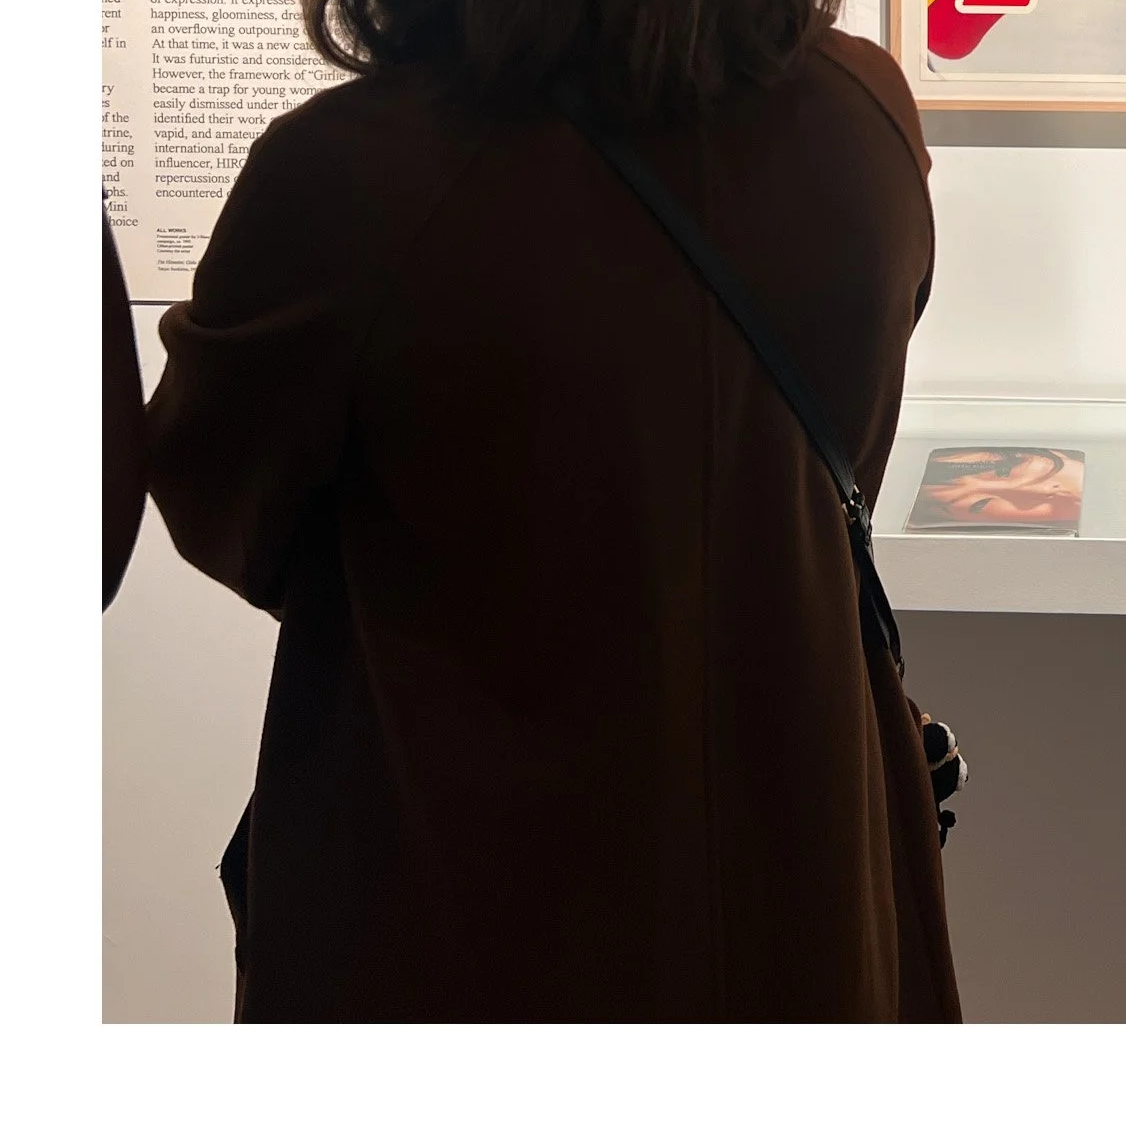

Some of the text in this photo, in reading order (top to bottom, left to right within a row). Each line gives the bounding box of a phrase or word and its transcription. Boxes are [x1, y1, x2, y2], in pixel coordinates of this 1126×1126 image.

[150, 8, 208, 22] happiness,
[212, 9, 277, 23] gloominess,
[151, 26, 165, 34] an
[168, 23, 235, 38] overflowing
[238, 25, 299, 38] outpouring
[116, 38, 126, 48] in
[152, 39, 165, 49] At
[168, 38, 188, 49] that
[192, 38, 218, 50] time,
[223, 39, 229, 49] it
[232, 42, 254, 50] was
[257, 42, 263, 50] a
[267, 42, 290, 50] new
[153, 53, 159, 64] It
[163, 56, 186, 64] was
[190, 53, 239, 65] futuristic
[243, 54, 262, 65] and
[152, 68, 205, 80] However,
[208, 69, 226, 80] the
[228, 69, 291, 81] framework
[294, 69, 307, 81] of
[153, 83, 195, 94] became
[198, 86, 205, 94] a
[208, 85, 230, 97] trap
[233, 84, 249, 95] for
[252, 87, 286, 98] young
[153, 98, 186, 112] easily
[189, 98, 243, 110] dismissed
[247, 99, 279, 110] under
[112, 112, 129, 123] the
[154, 112, 205, 124] identified
[209, 113, 234, 124] their
[238, 114, 267, 125] work
[154, 128, 187, 141] vapid,
[192, 128, 211, 139] and
[155, 142, 224, 154] international
[156, 157, 212, 170] influencer,
[155, 173, 230, 186] repercussions
[156, 187, 223, 198] encountered
